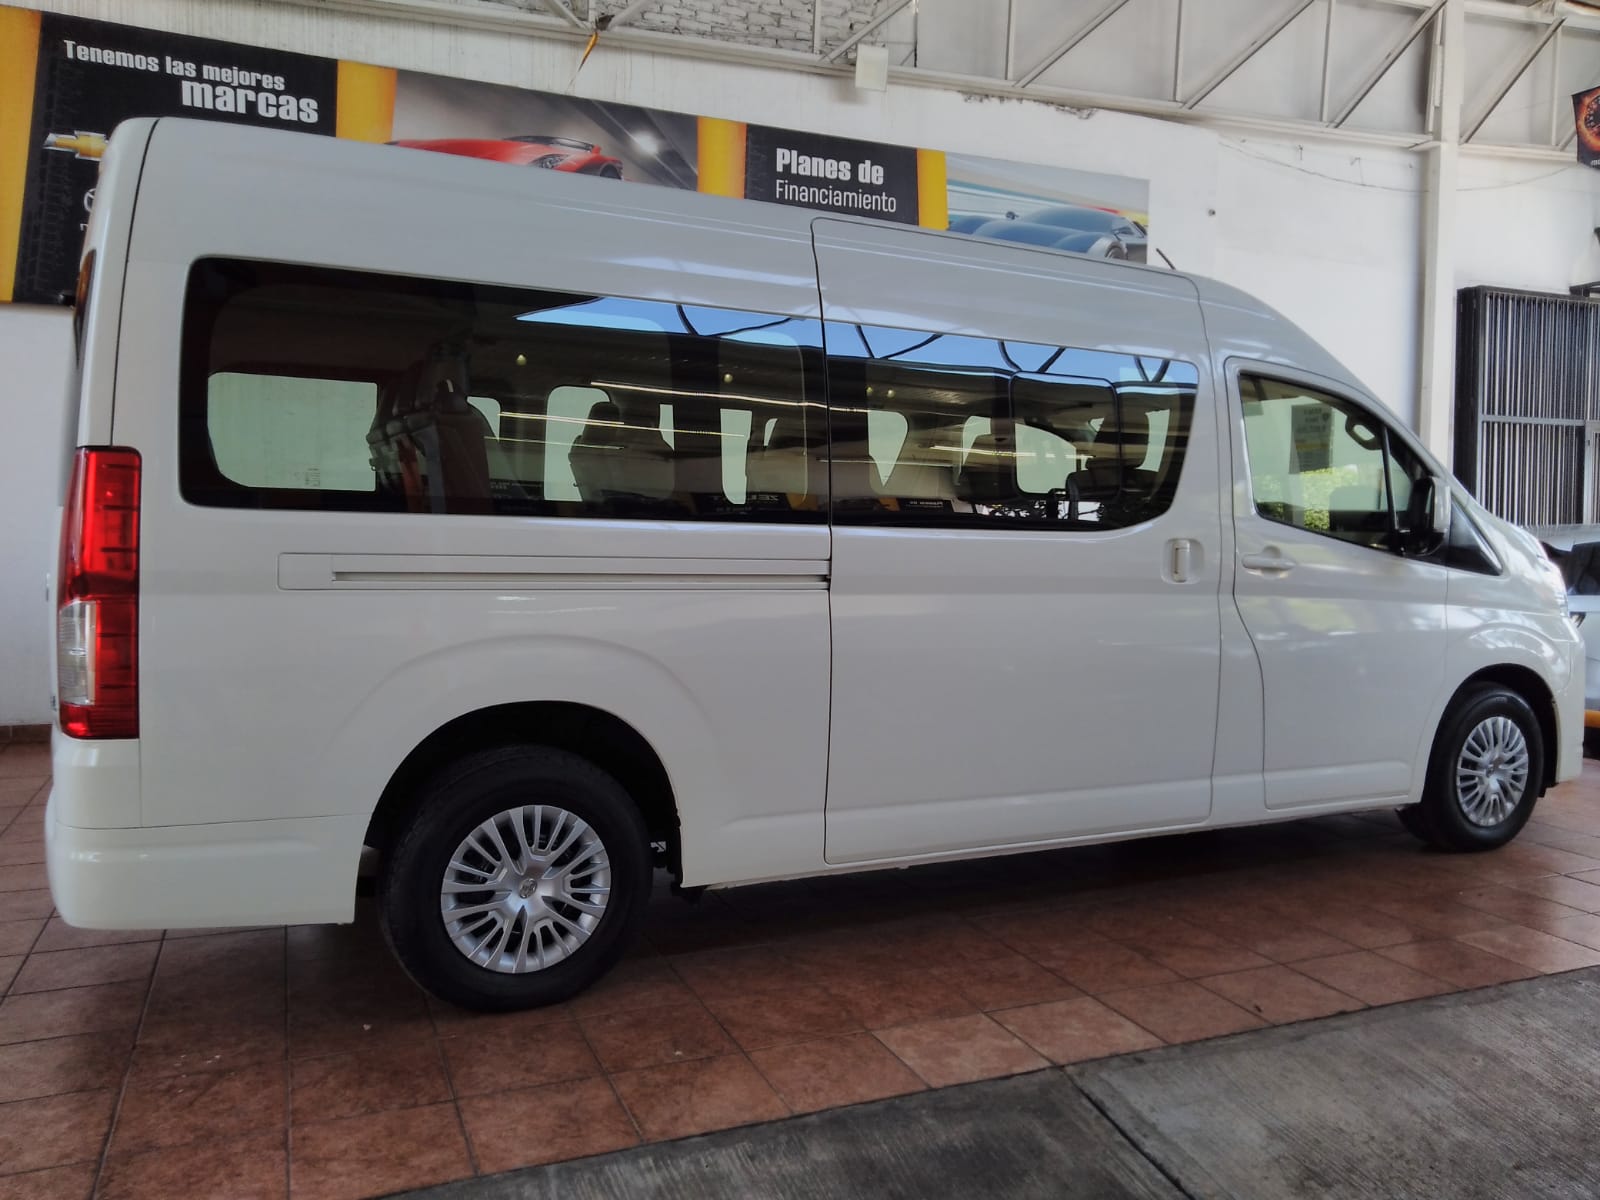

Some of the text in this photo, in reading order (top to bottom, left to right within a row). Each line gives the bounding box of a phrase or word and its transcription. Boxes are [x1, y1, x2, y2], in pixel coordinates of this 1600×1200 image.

[64, 40, 286, 91] Tenemos las mejores
[181, 80, 319, 124] marcas
[776, 147, 884, 185] Planes de
[776, 179, 897, 213] Financiamiento
